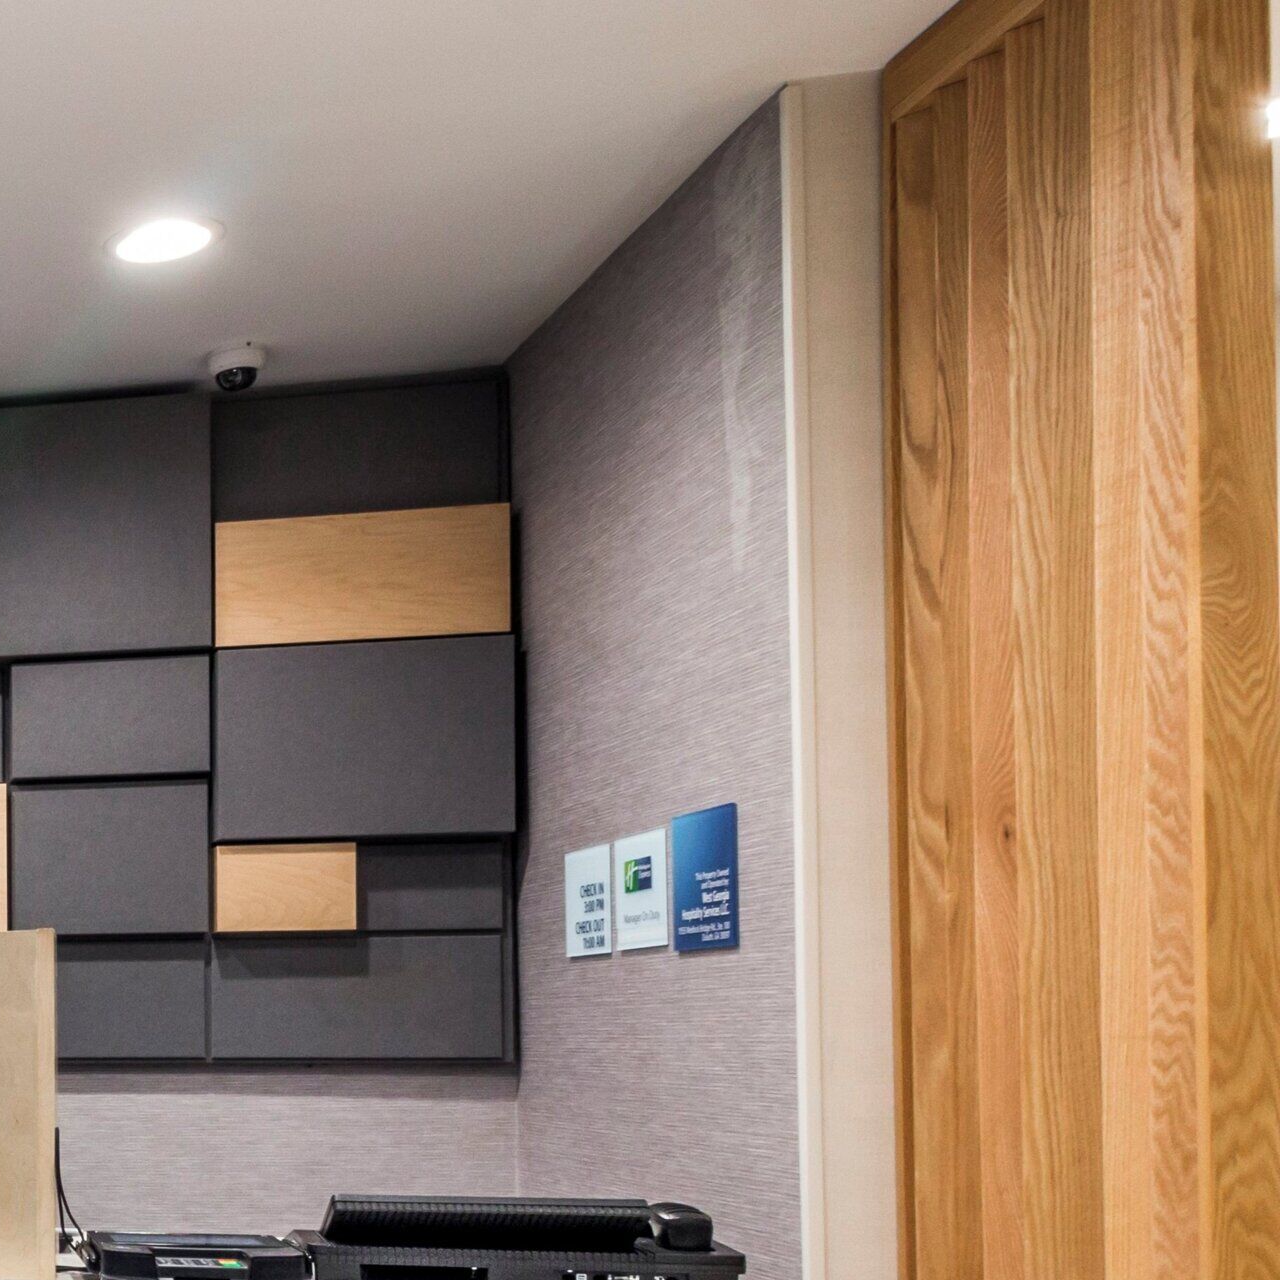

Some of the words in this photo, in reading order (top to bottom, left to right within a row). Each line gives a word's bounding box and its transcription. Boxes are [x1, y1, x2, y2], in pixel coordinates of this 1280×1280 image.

[580, 883, 597, 898] CHECK
[598, 882, 604, 895] IN
[596, 898, 604, 911] PM
[575, 920, 592, 934] CHECK
[593, 918, 604, 932] OUT
[596, 935, 605, 947] AM
